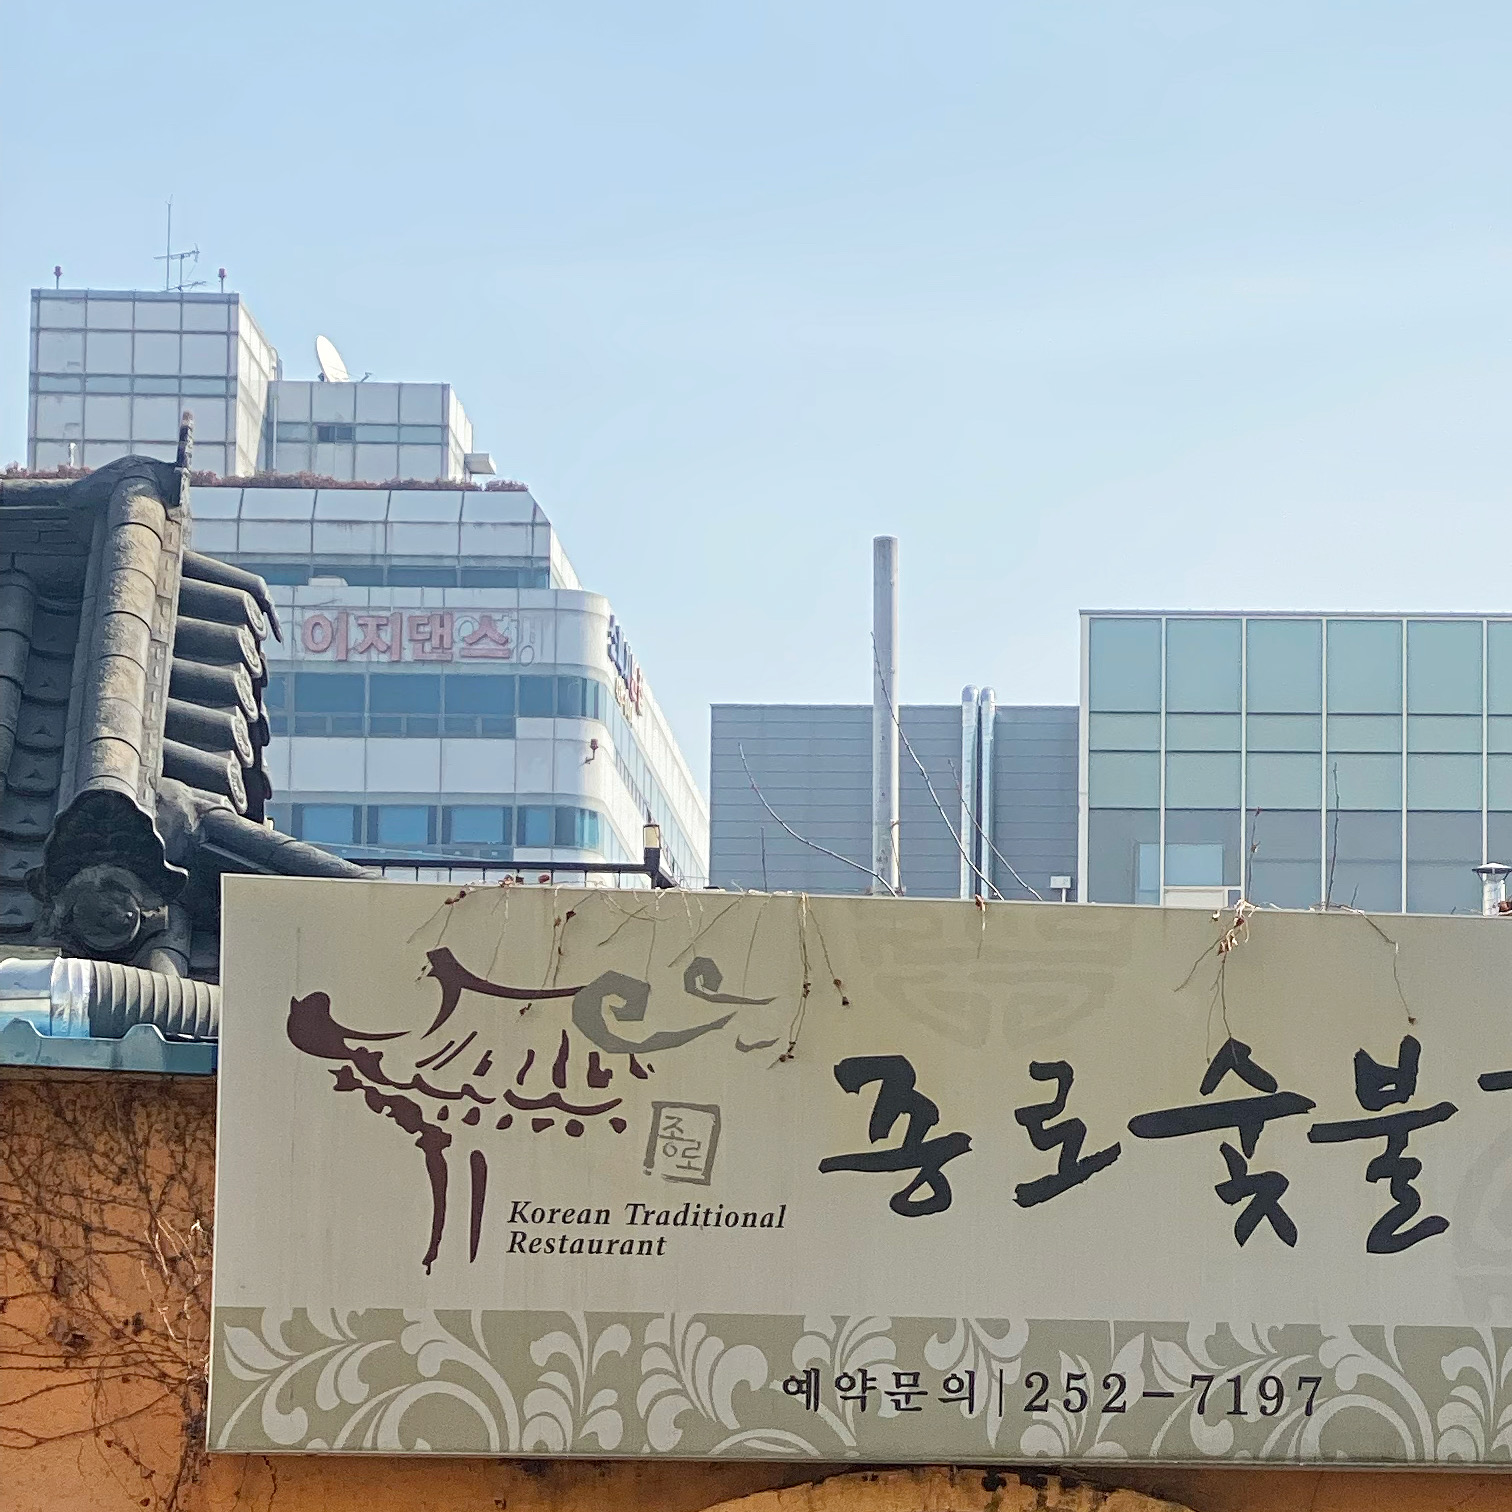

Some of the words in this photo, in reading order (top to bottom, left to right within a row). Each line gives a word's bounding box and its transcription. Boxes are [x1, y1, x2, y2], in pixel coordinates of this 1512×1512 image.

[303, 611, 511, 662] 이지댄스
[507, 1200, 610, 1226] Korean
[624, 1201, 787, 1229] Traditional
[506, 1230, 667, 1257] Restaurant
[781, 1368, 976, 1416] 예약문의
[1023, 1370, 1323, 1418] 252-7197
